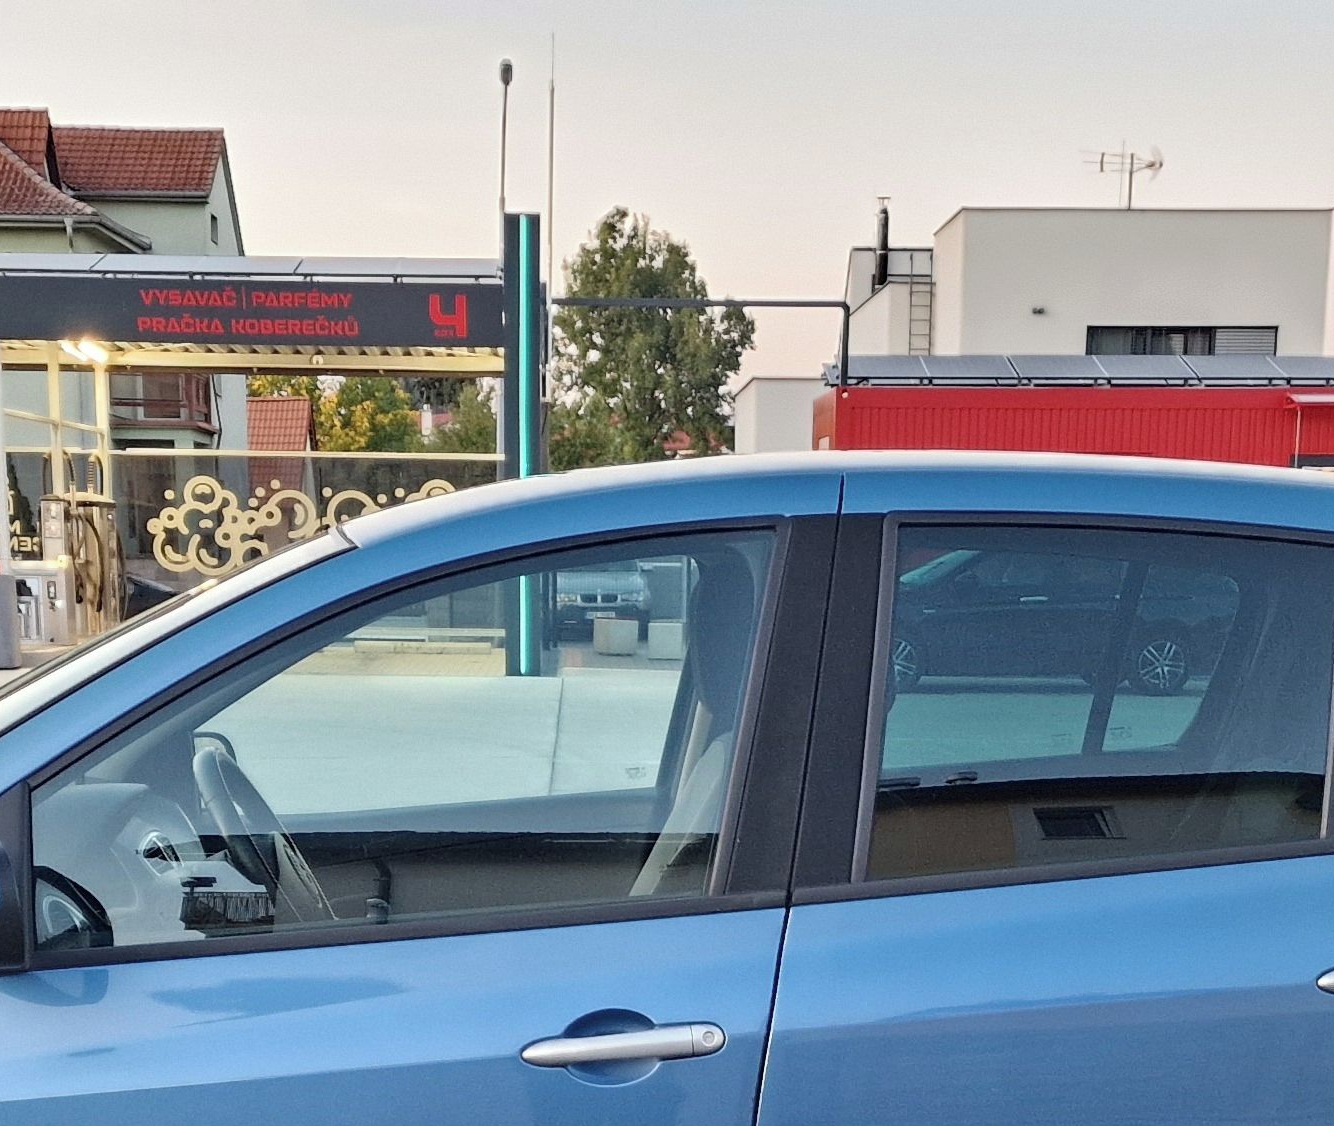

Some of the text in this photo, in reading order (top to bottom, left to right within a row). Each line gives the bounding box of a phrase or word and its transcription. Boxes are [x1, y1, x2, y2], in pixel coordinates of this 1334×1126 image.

[140, 287, 353, 309] VYSAVAČ PARFÉMY
[137, 314, 360, 337] PRAČKA KOBEREČKŮ
[428, 292, 468, 338] 4
